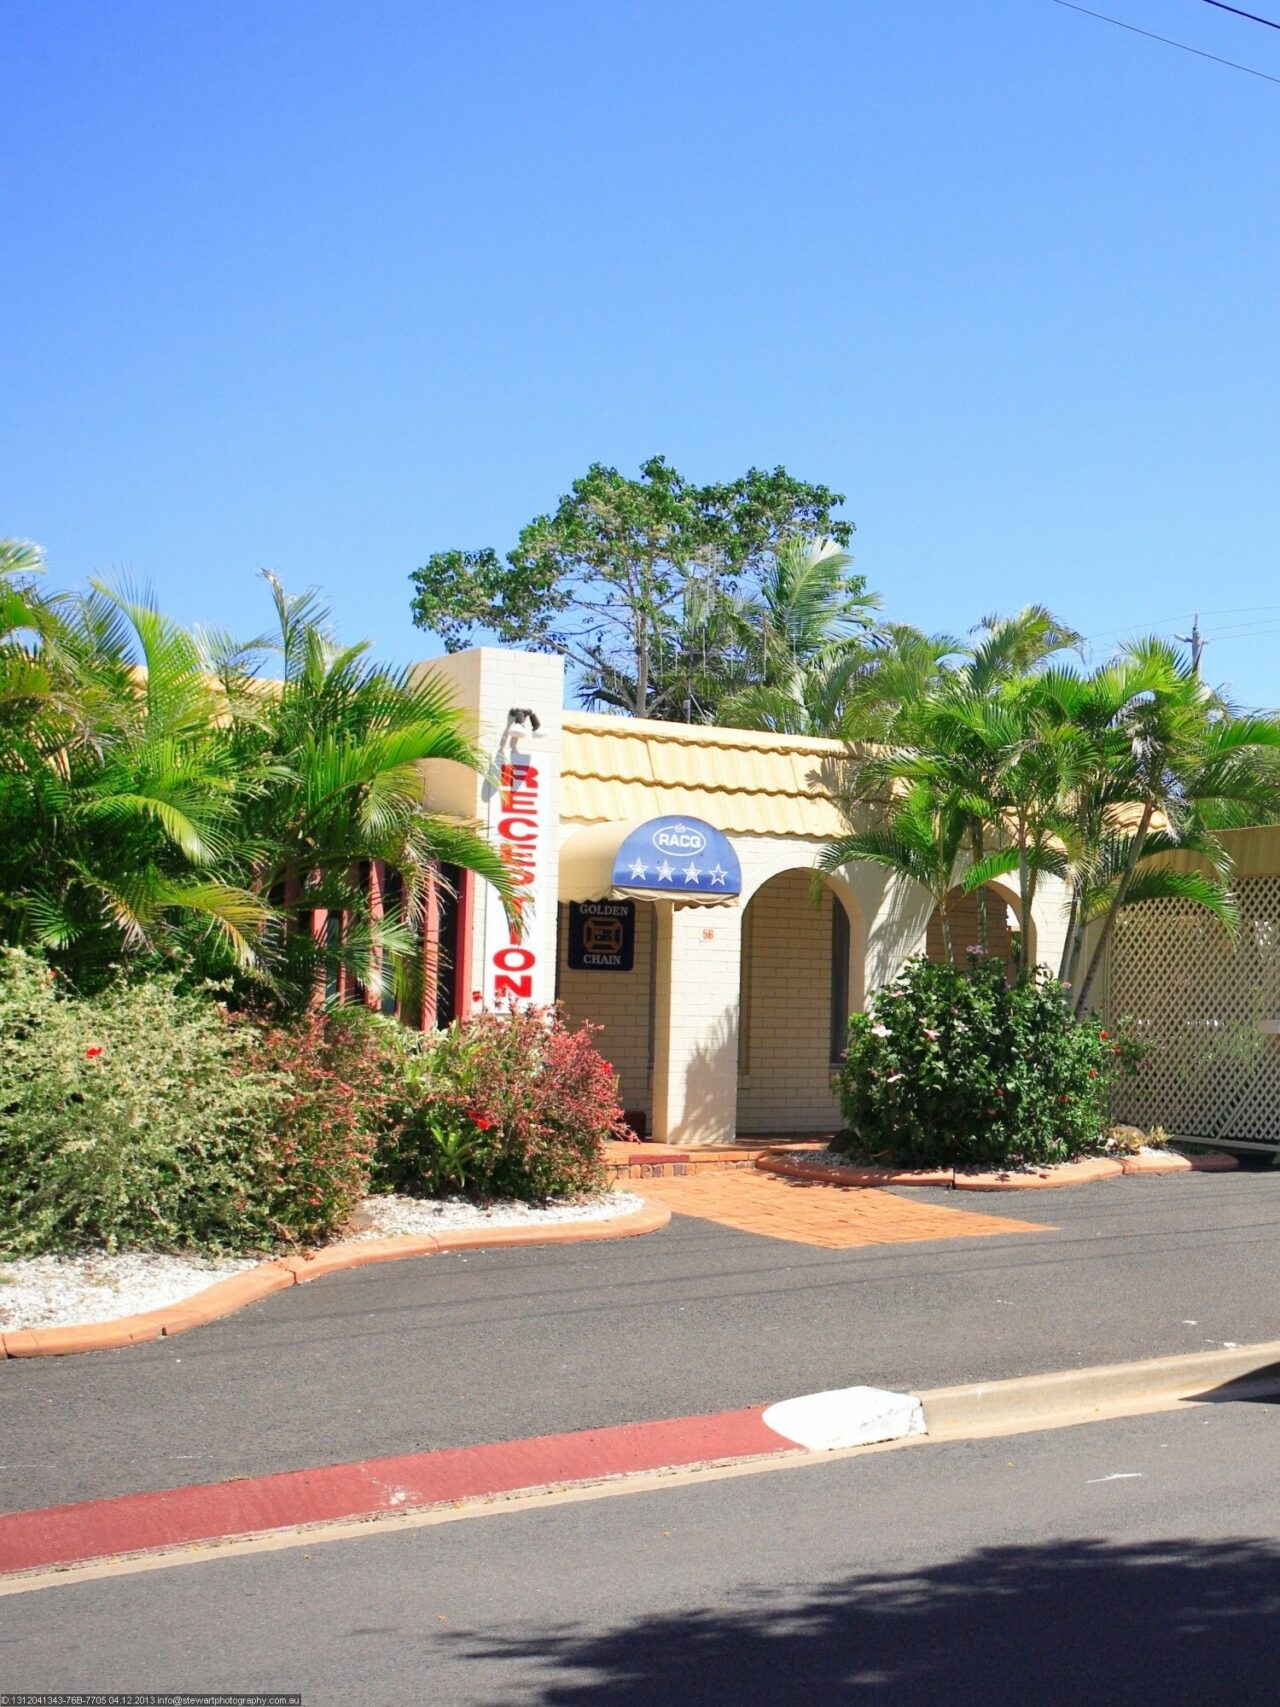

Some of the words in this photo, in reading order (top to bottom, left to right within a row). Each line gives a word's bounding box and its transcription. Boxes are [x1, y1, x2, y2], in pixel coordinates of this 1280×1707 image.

[658, 833, 702, 849] RACQ
[580, 903, 629, 917] GOLDEN
[583, 953, 621, 966] CHAIN
